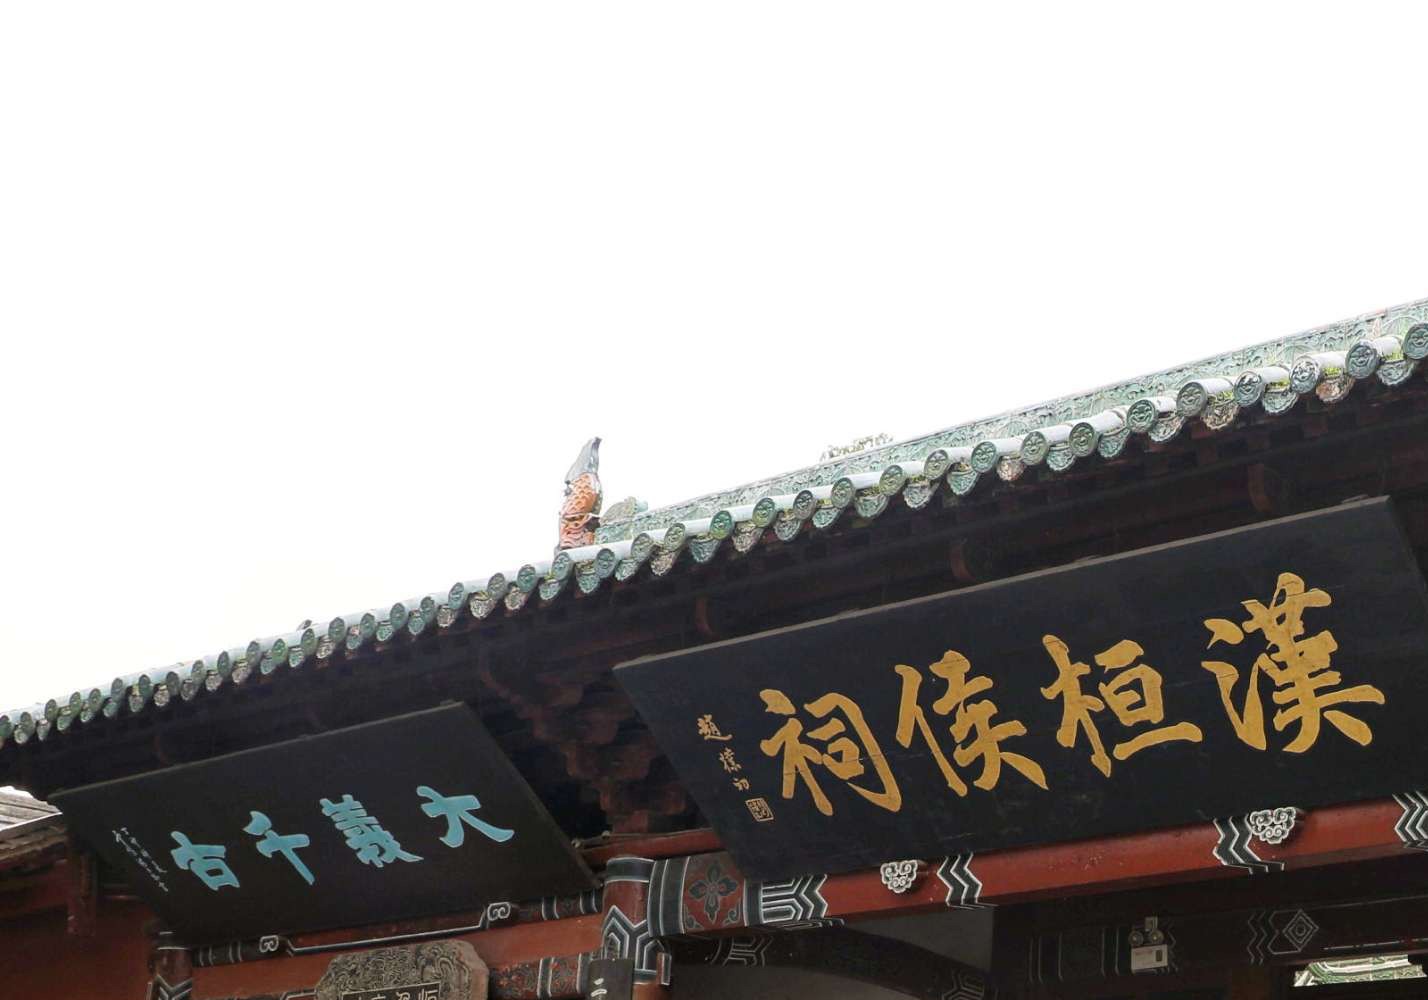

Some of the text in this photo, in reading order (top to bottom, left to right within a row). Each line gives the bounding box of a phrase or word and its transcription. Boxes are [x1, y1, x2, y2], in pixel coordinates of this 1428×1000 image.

[759, 571, 1386, 817] 漢桓侯祠
[171, 786, 515, 892] 大義千古
